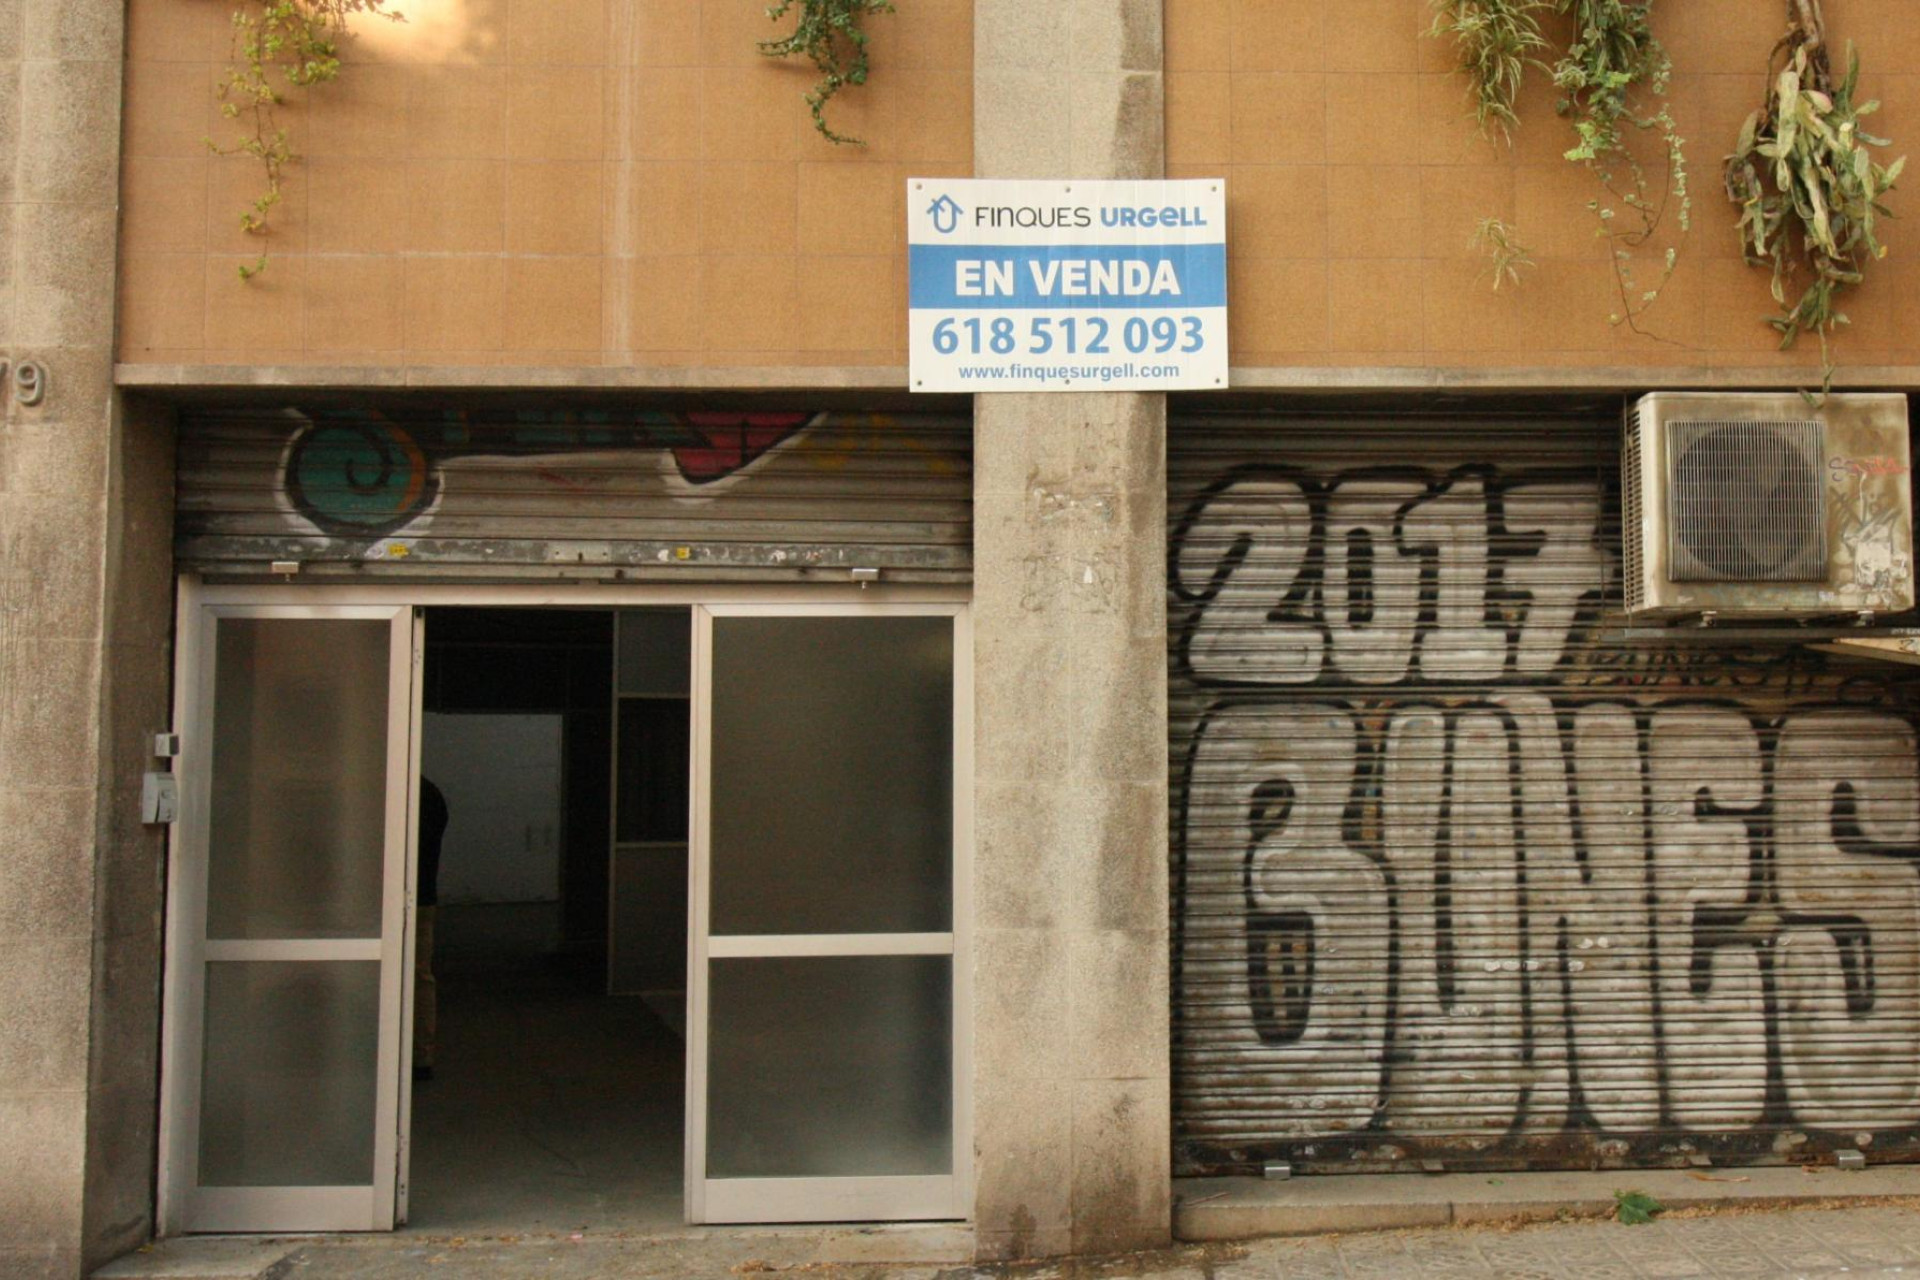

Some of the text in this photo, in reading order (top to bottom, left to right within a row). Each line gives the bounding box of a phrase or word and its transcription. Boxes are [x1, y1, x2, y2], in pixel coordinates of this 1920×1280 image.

[955, 259, 1181, 296] EN VENDA
[932, 316, 1205, 355] 618 512 093
[958, 362, 1180, 382] www.finquesurgell.com
[1168, 465, 1620, 687] 2017
